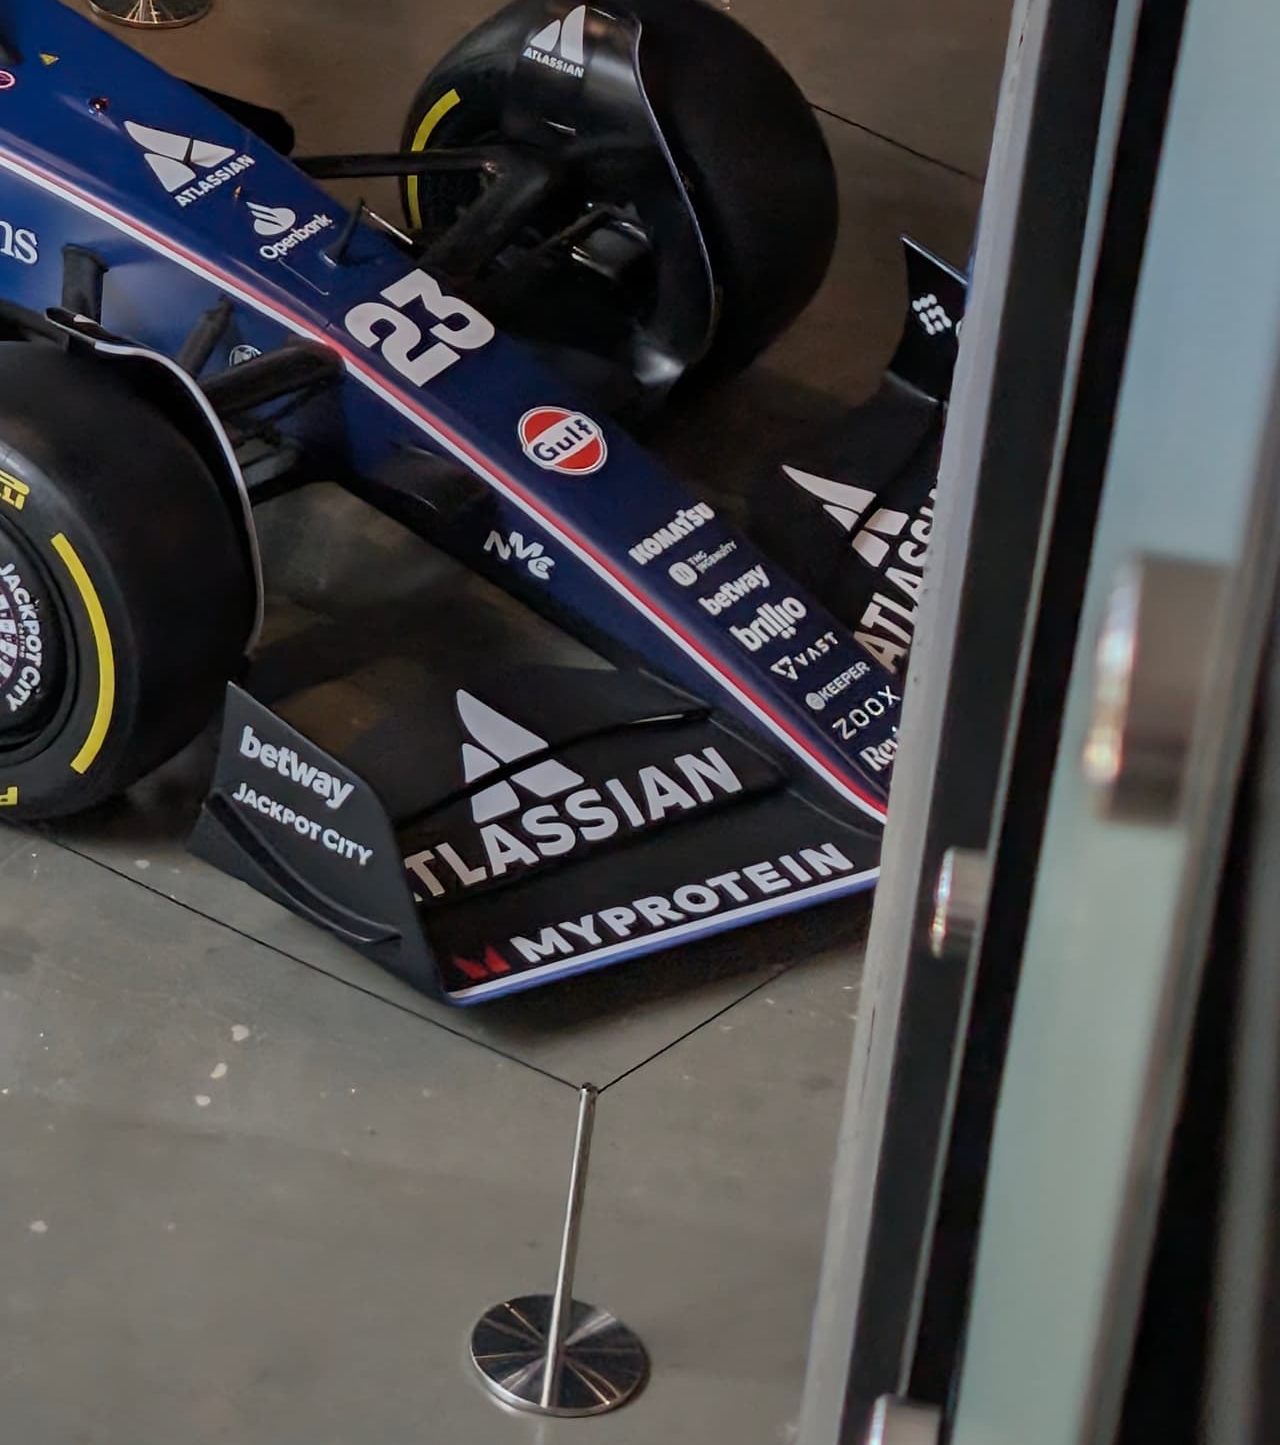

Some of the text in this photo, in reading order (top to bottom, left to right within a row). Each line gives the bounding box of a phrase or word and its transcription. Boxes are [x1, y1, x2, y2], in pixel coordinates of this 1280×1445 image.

[523, 46, 585, 79] ATLASSIAN
[174, 154, 256, 208] ATLASSIAN
[260, 211, 334, 261] Openbank
[344, 268, 496, 388] 23
[532, 418, 594, 463] Gulf
[628, 502, 716, 566] KOMATSU
[698, 564, 771, 616] betway
[729, 596, 807, 652] brillio
[793, 631, 839, 667] VAST
[819, 661, 871, 703] KEEPER
[831, 685, 902, 741] ZOOX
[239, 725, 355, 811] betway
[404, 746, 743, 903] TLASSIAN
[510, 840, 855, 966] MYPROTEIN
